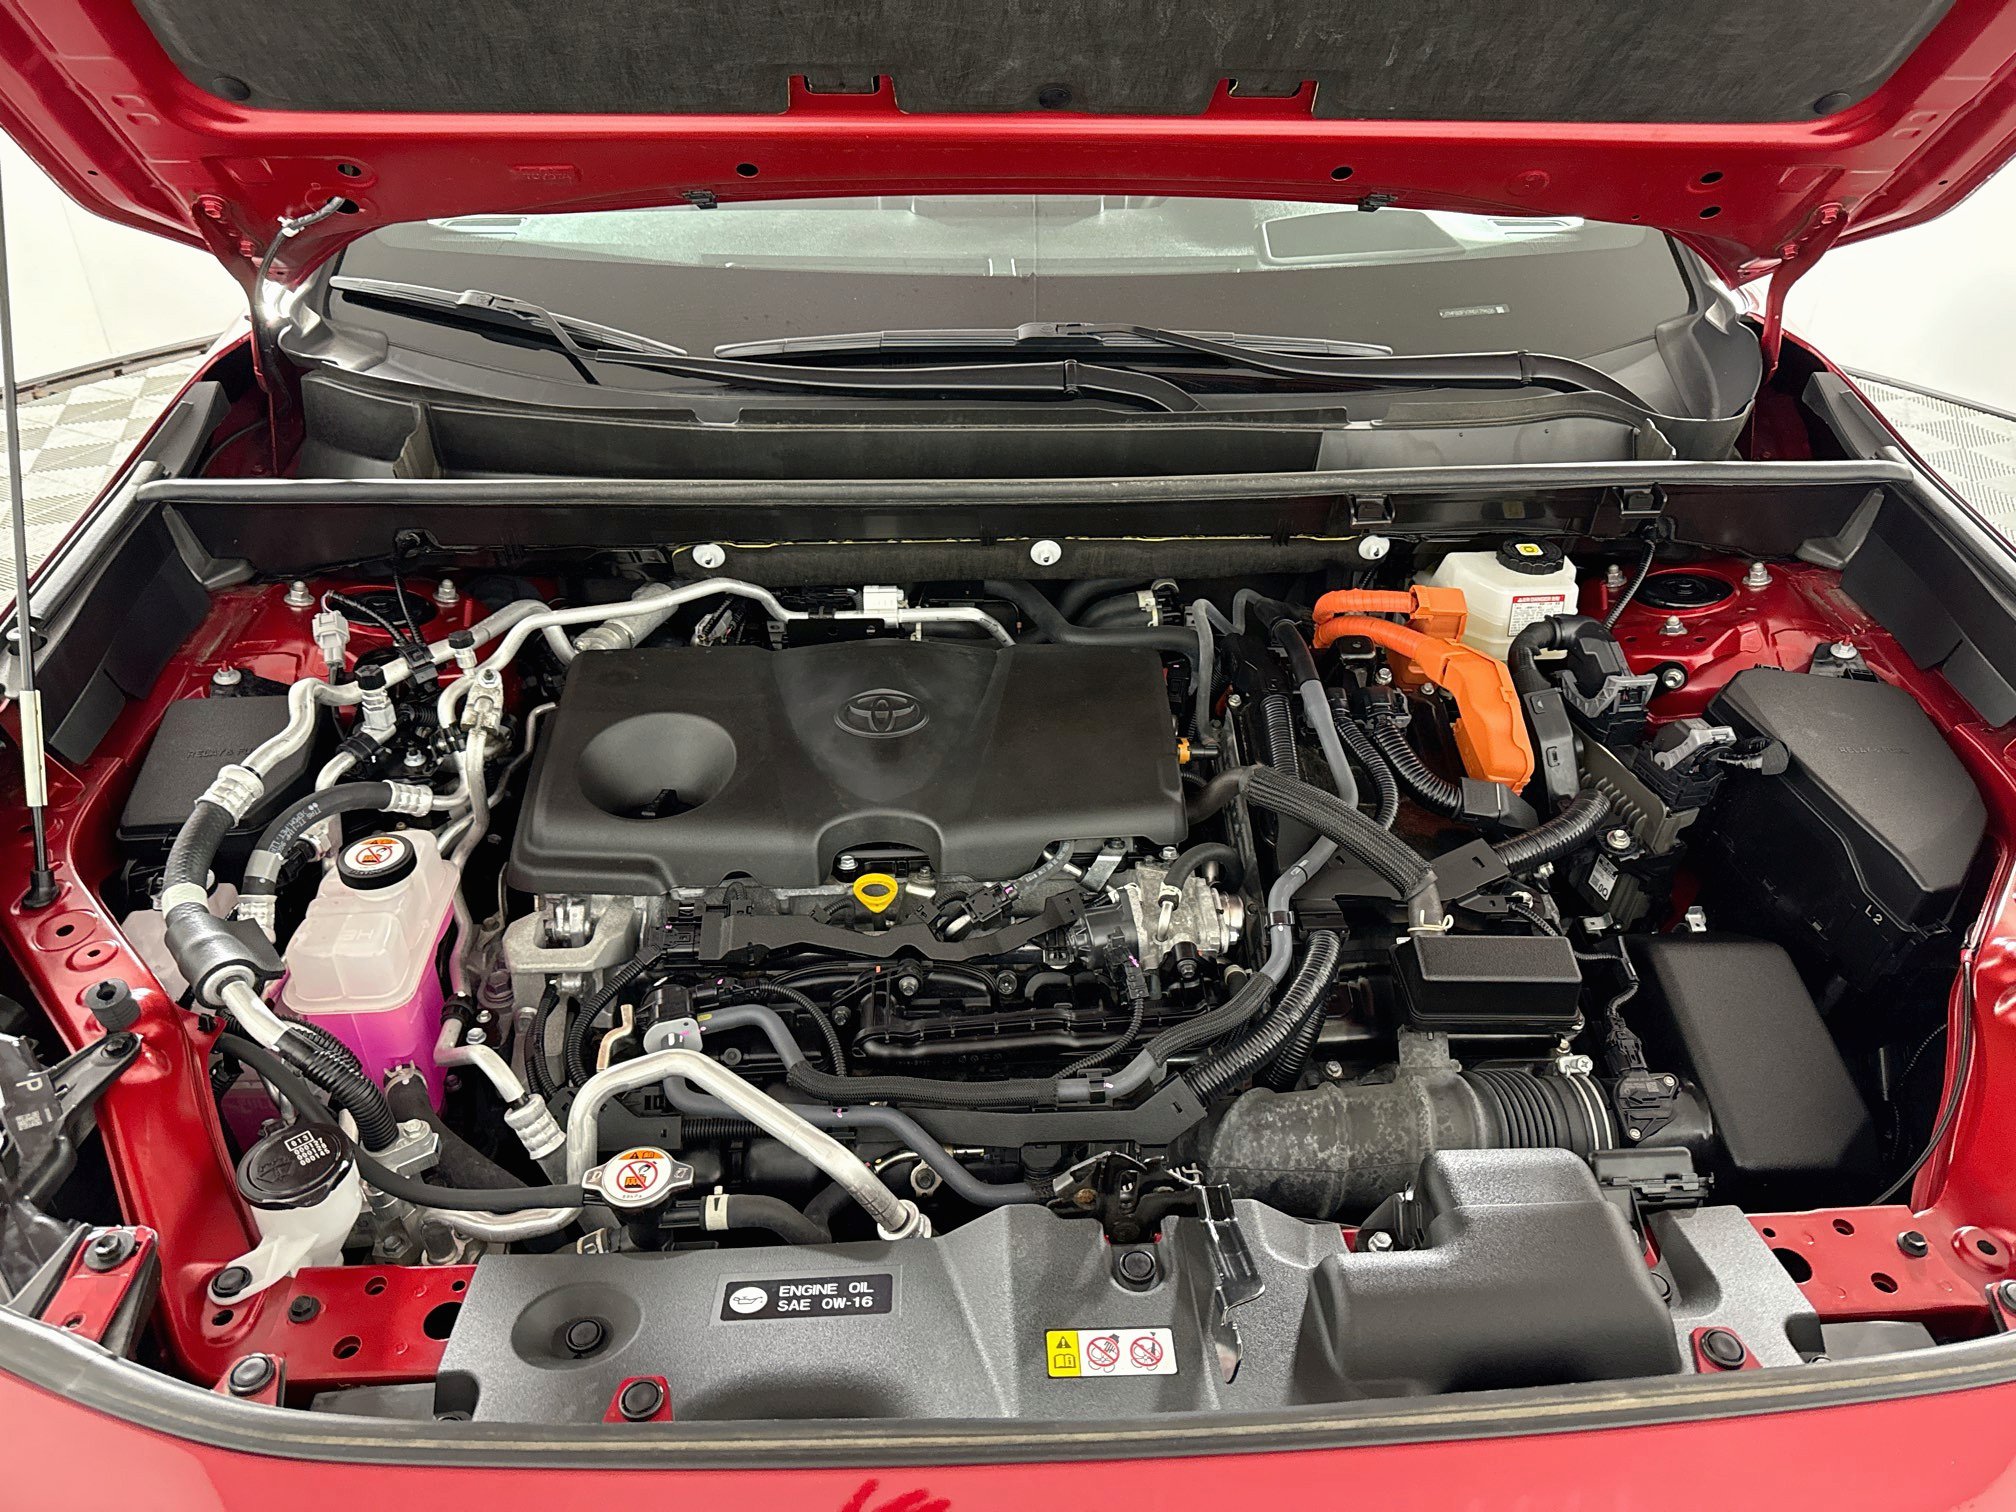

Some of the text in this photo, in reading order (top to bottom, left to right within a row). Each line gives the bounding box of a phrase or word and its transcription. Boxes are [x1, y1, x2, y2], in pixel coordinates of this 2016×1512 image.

[1864, 904, 1883, 926] L2
[294, 1137, 323, 1155] 000127
[778, 1281, 875, 1297] ENGINE OIL
[776, 1296, 873, 1312] SAE 0W-16
